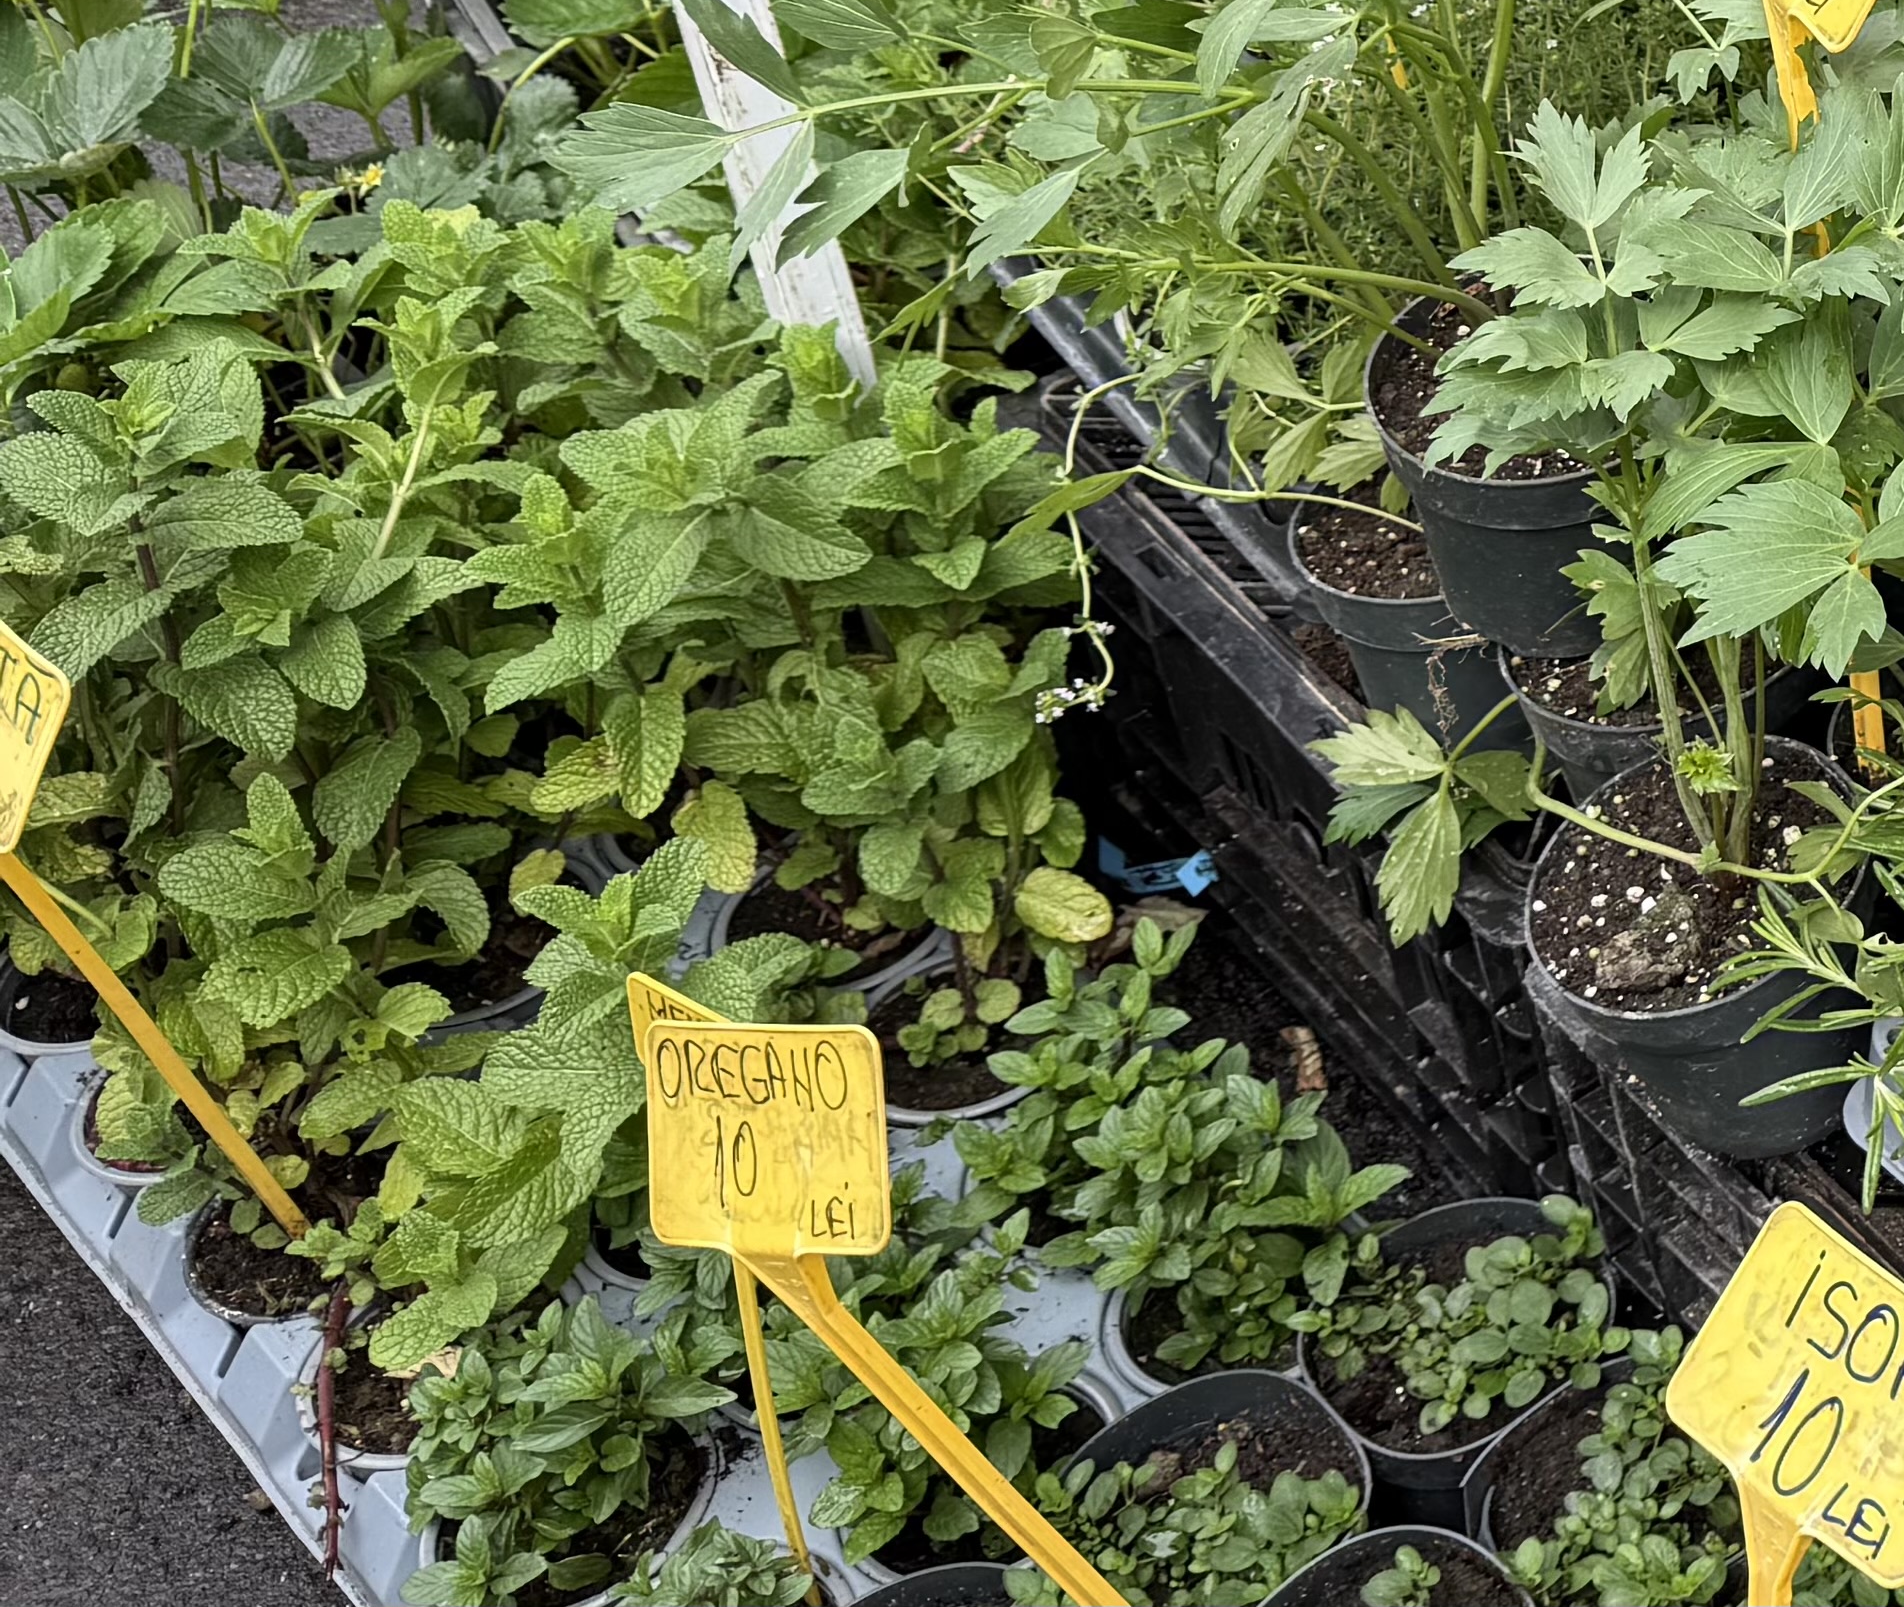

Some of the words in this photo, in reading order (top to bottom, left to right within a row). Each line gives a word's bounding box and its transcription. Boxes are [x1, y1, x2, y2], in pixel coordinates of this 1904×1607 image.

[656, 1037, 848, 1112] OREGANO
[714, 1114, 757, 1209] 10
[1750, 1367, 1843, 1497] 10
